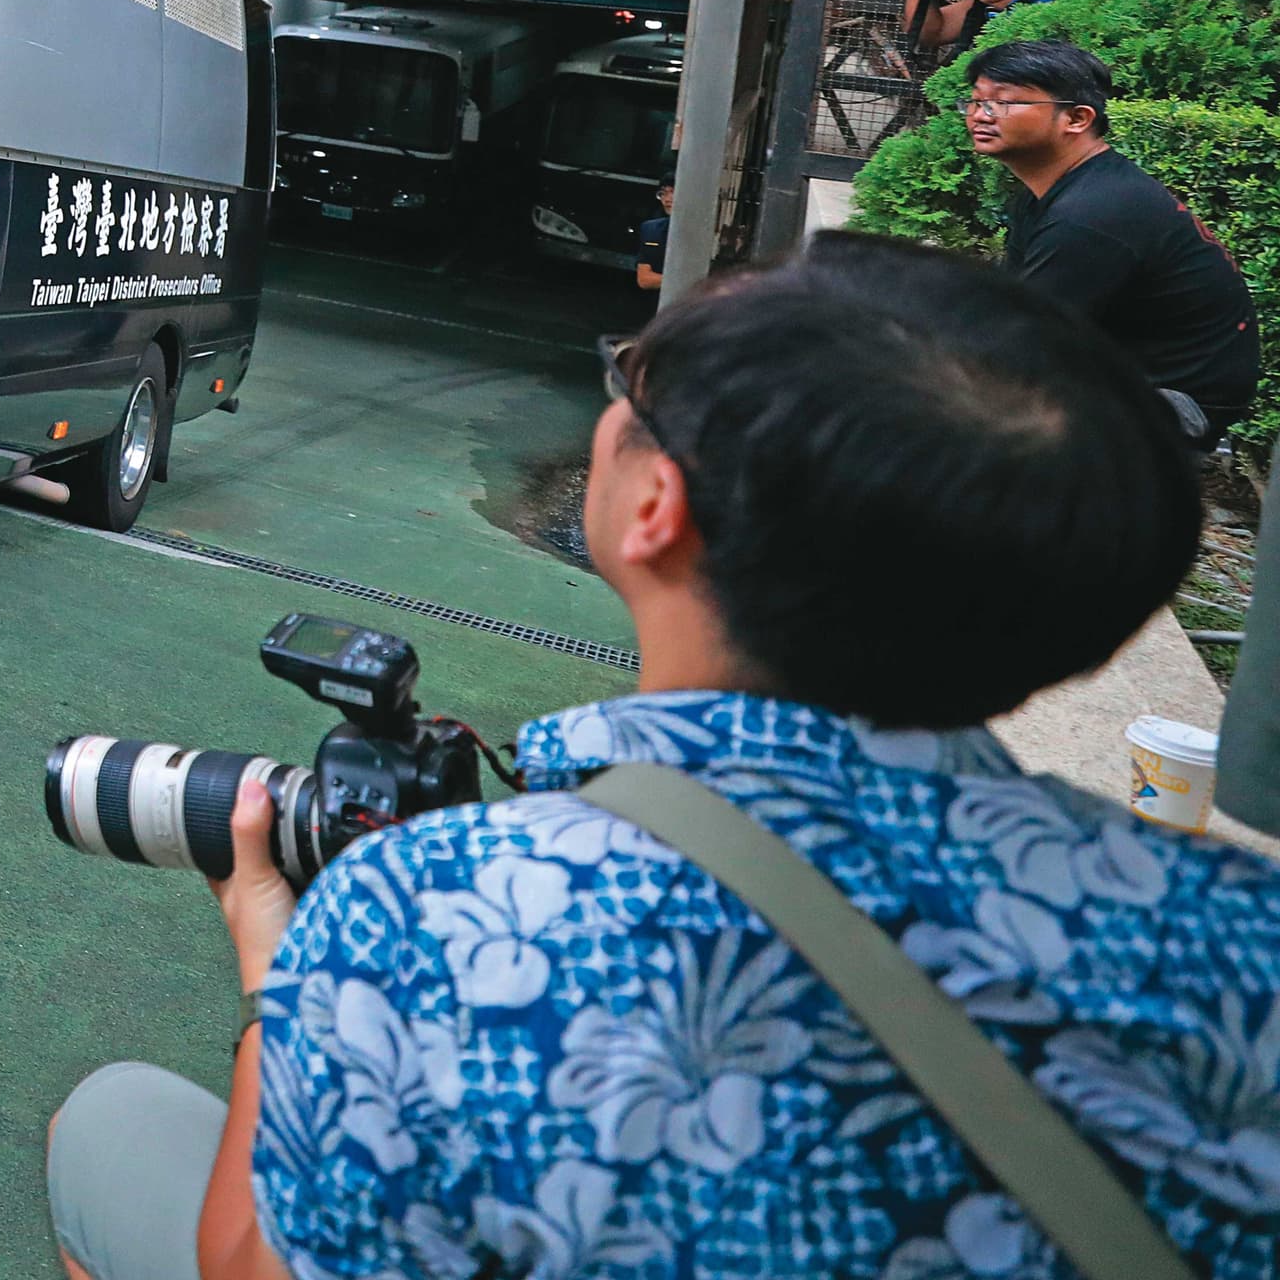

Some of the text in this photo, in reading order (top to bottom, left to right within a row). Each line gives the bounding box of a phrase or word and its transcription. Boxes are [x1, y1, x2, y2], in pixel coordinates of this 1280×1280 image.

[40, 173, 229, 259] 臺灣臺北地方檢察署
[31, 273, 222, 308] Taiwan Taipei District Prosecutors Office
